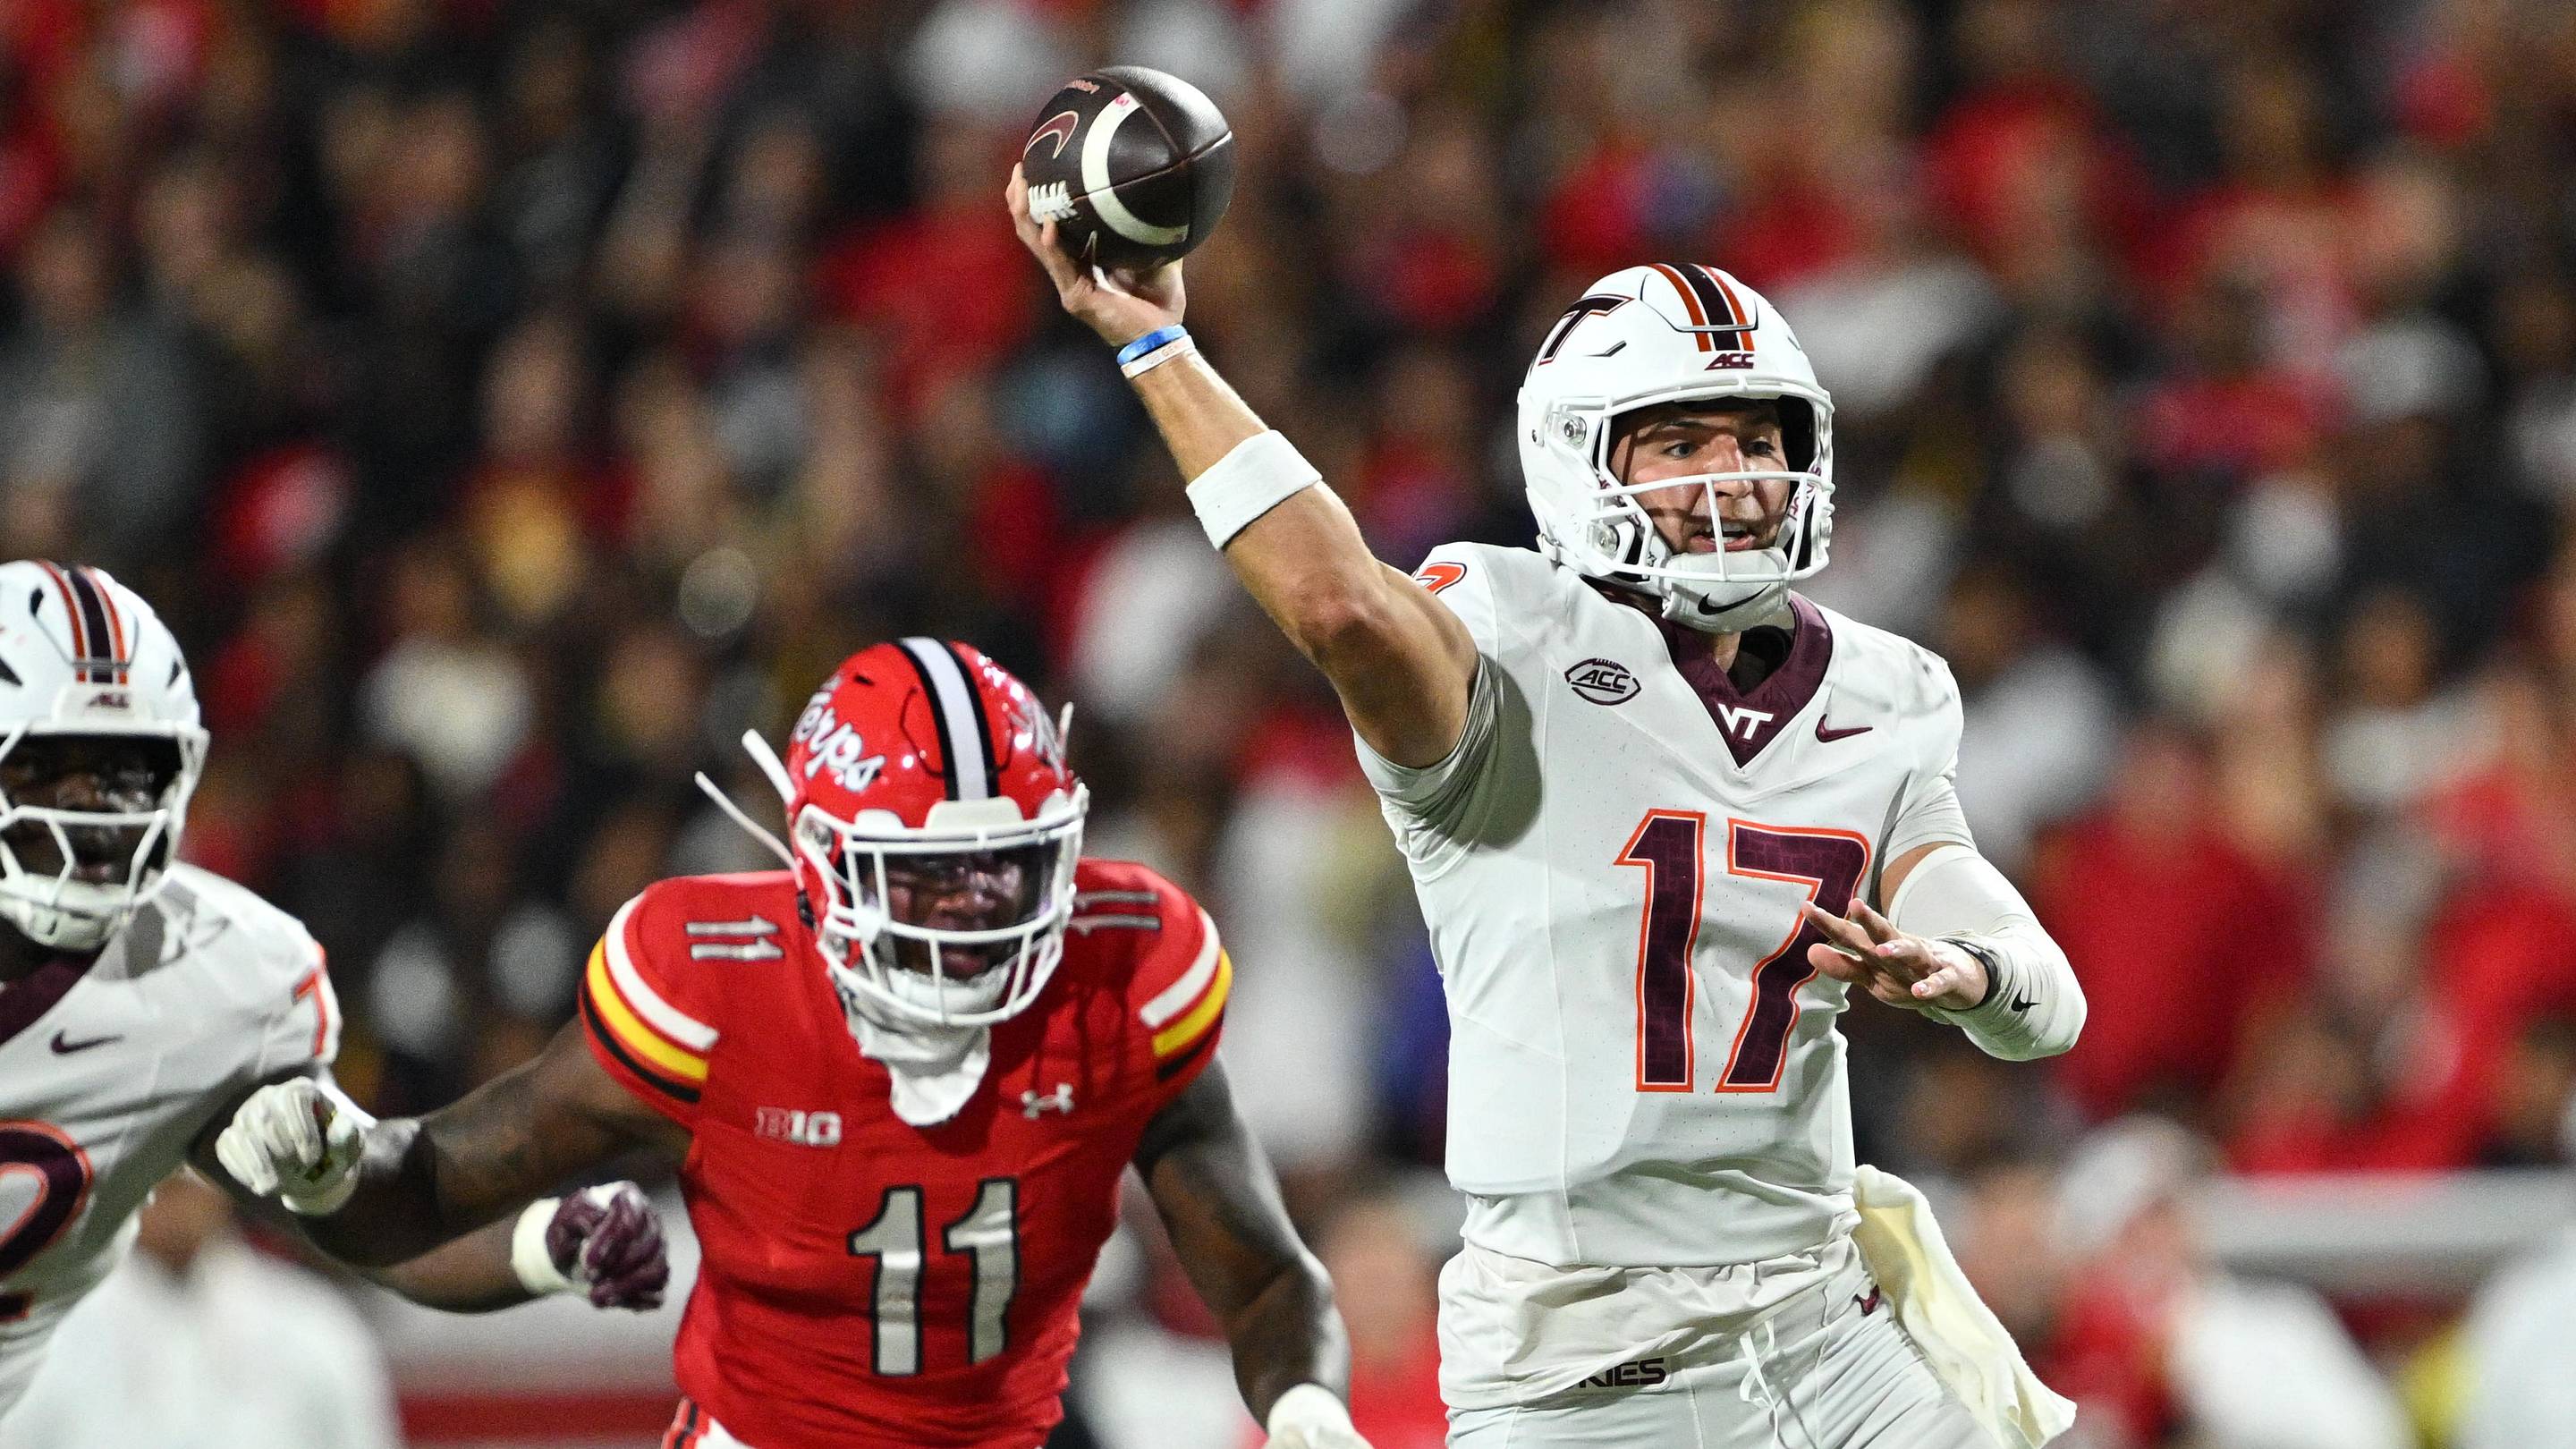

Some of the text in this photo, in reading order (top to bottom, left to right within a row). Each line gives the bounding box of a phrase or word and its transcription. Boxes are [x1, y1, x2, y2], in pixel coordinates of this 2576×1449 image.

[1704, 352, 1755, 370] ACC
[1574, 669, 1631, 692] ACC
[1717, 703, 1775, 741] VT
[685, 914, 784, 962] 11
[1613, 808, 1871, 1094] 17
[846, 1175, 1021, 1378] 11
